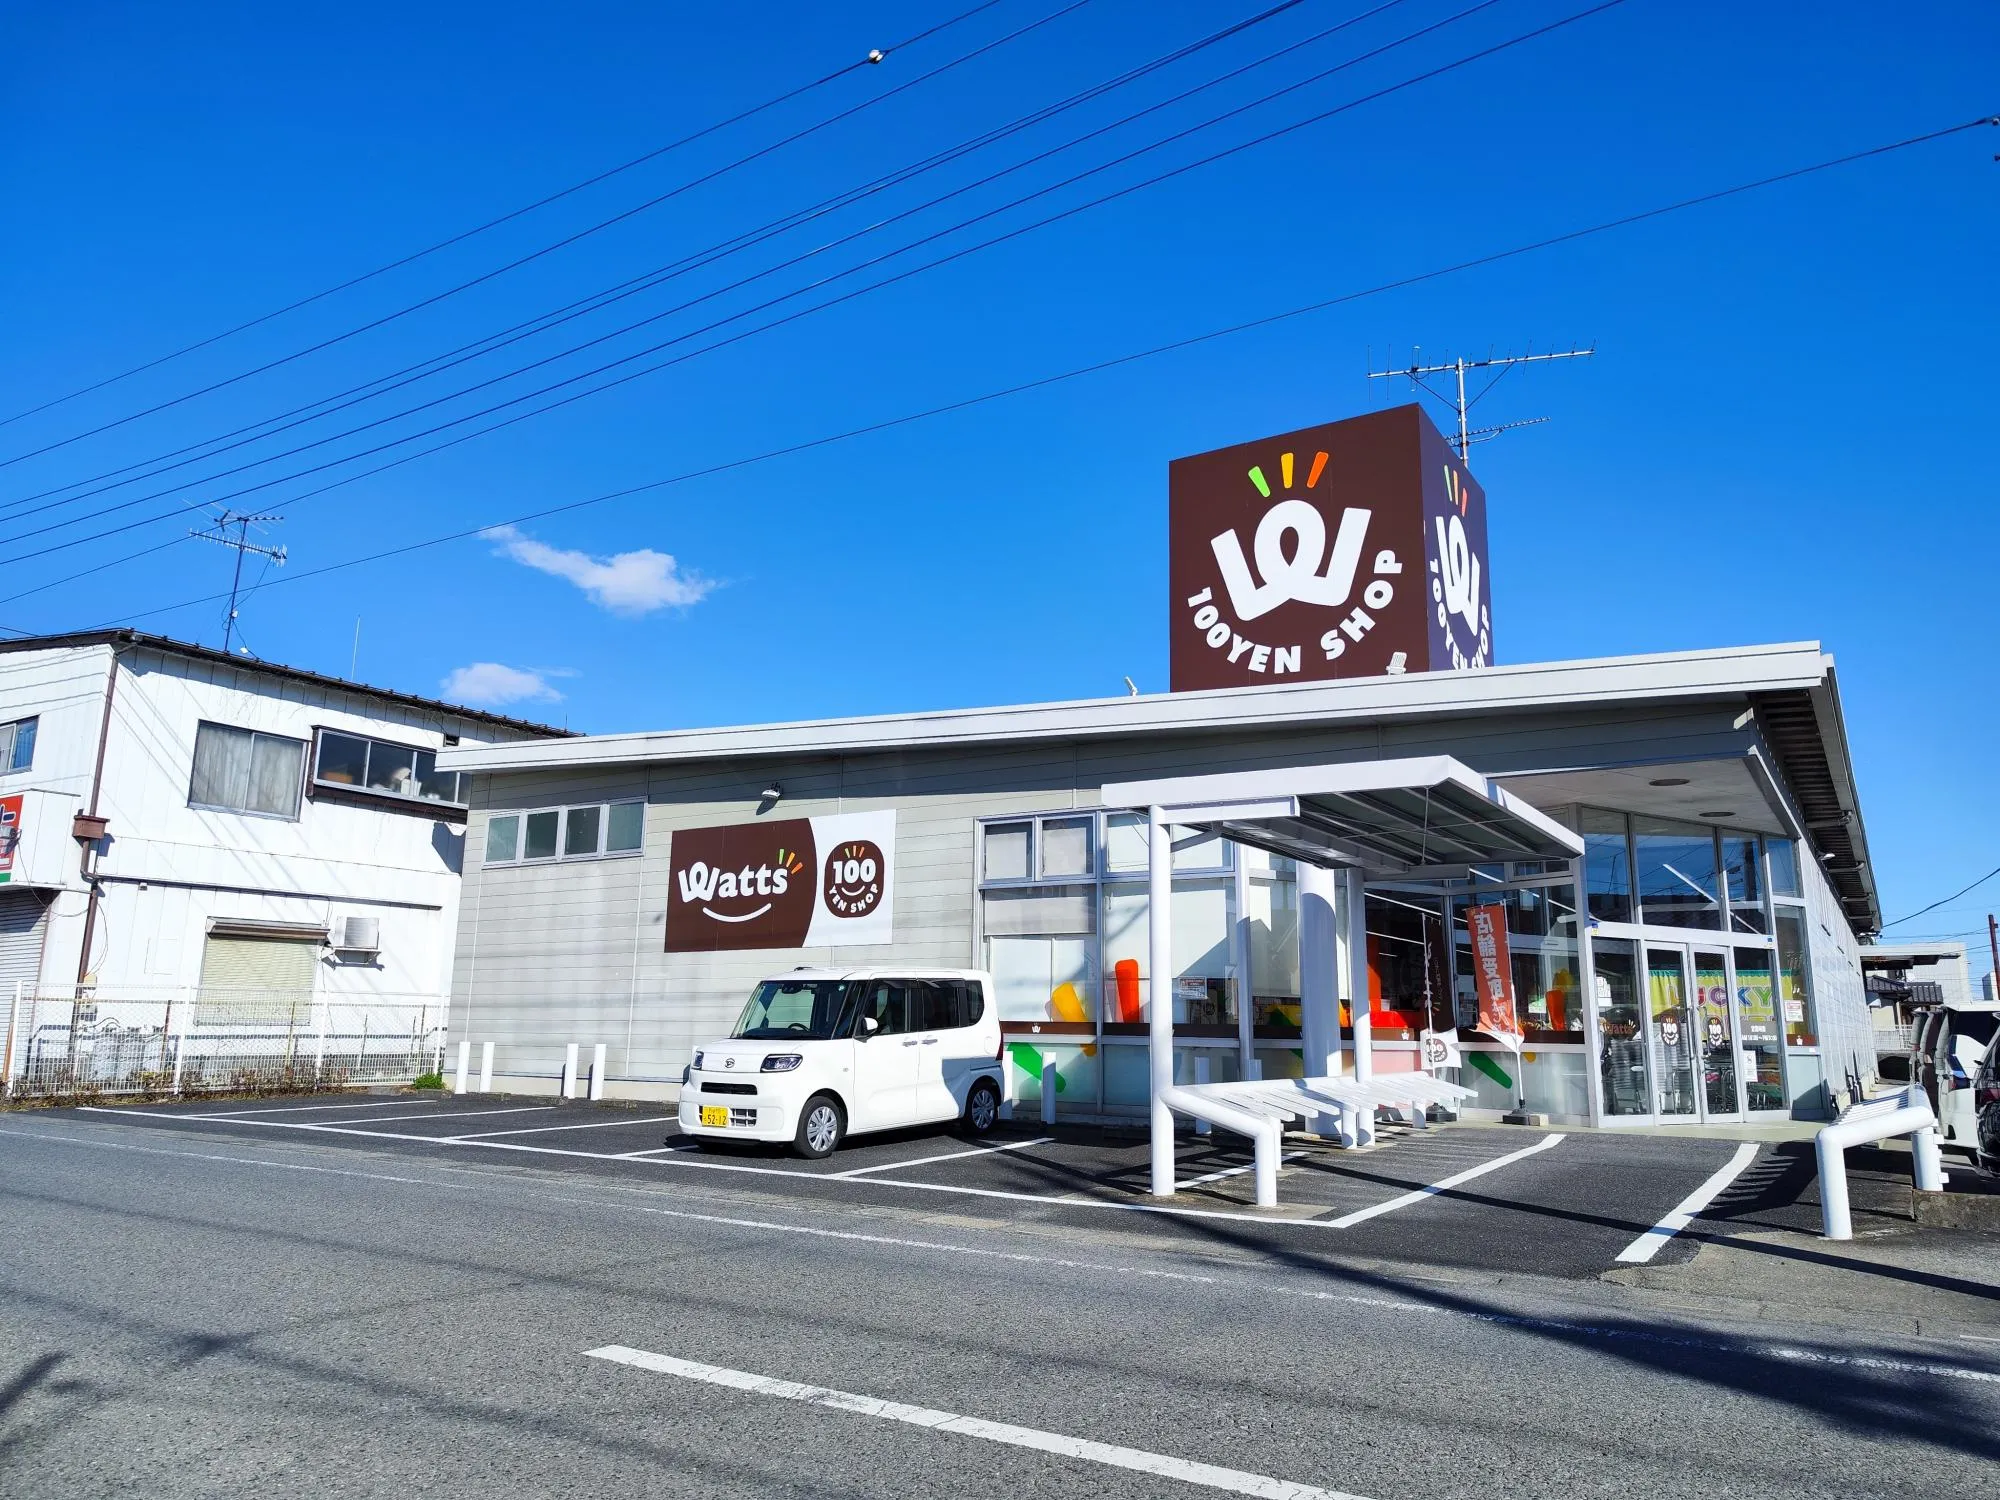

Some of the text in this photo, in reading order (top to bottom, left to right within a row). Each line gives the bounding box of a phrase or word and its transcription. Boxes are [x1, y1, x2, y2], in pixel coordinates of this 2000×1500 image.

[1319, 549, 1403, 661] SHOP
[677, 861, 789, 903] Watts
[832, 858, 877, 884] 100
[828, 883, 879, 914] YEN SHOP
[1662, 1022, 1678, 1034] 100
